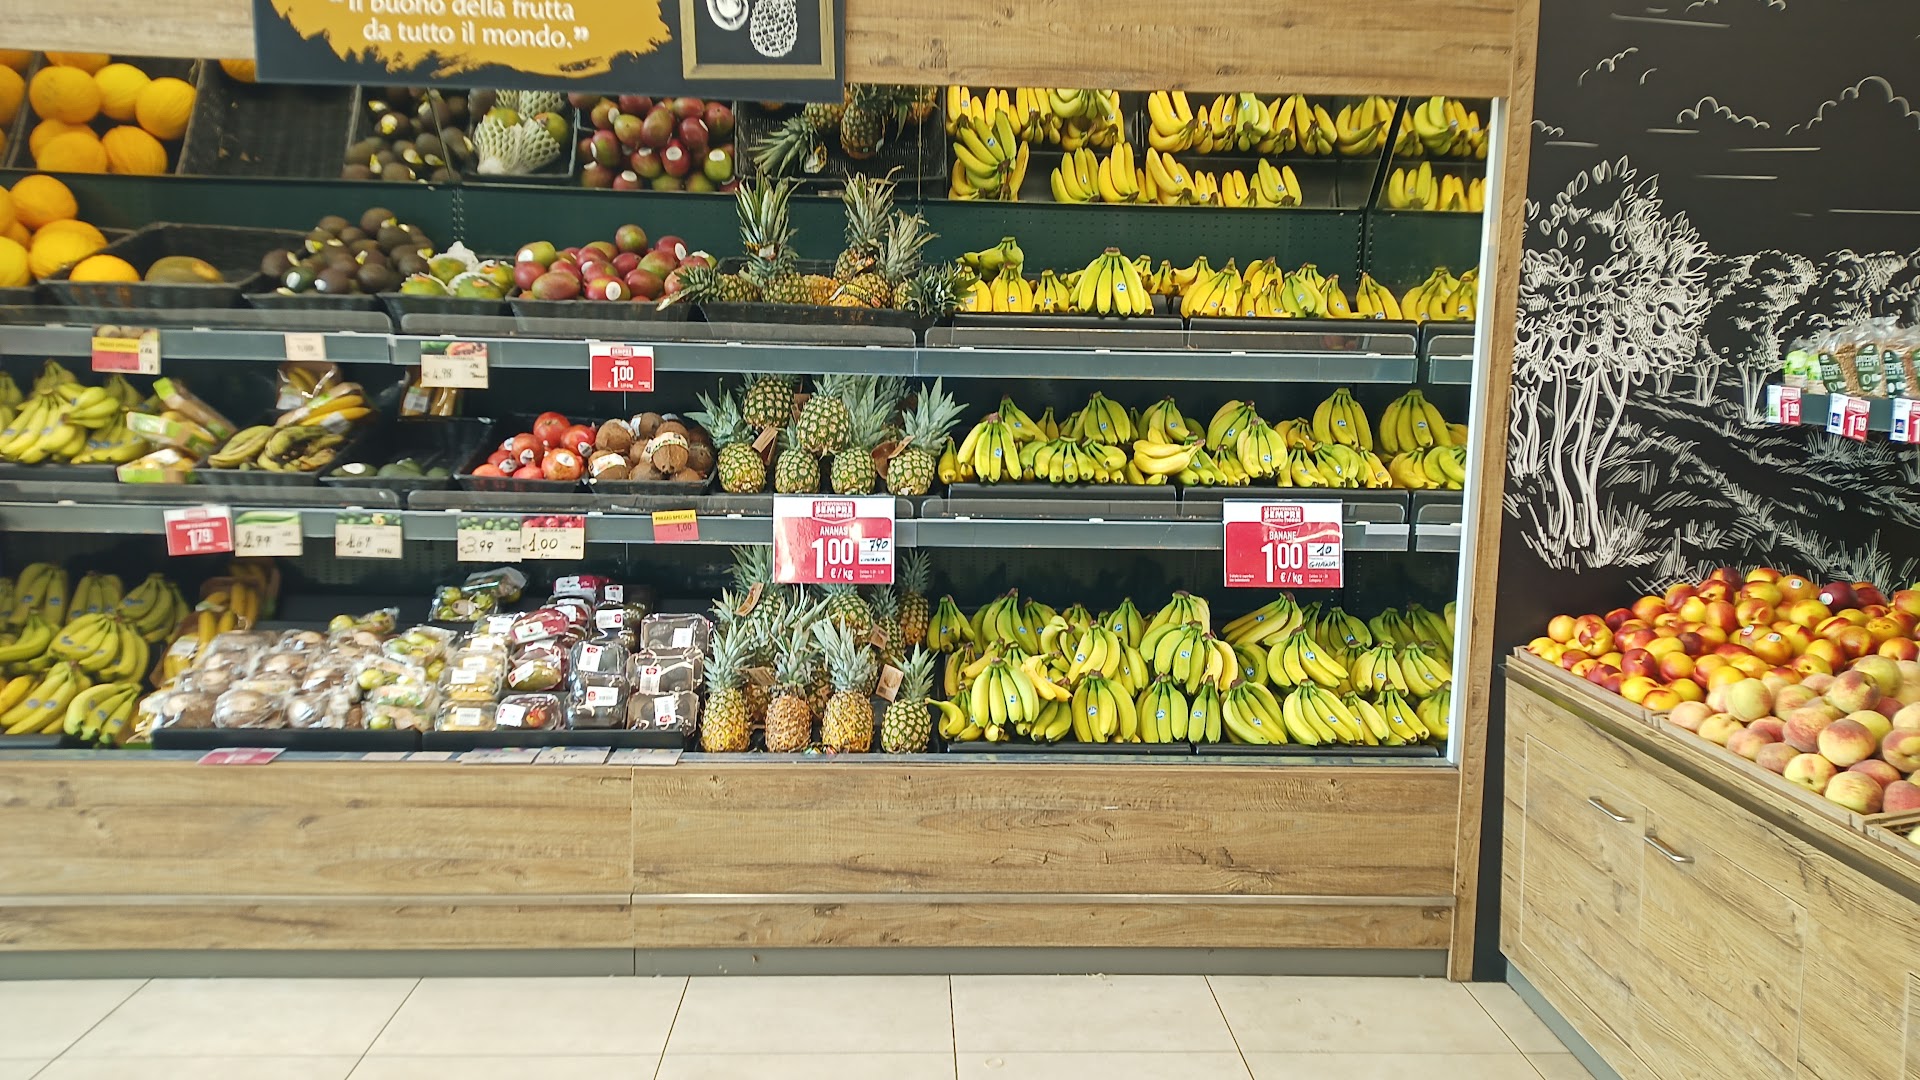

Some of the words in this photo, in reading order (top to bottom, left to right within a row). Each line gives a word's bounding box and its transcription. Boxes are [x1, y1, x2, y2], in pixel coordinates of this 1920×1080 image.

[452, 0, 506, 18] della
[363, 17, 392, 41] da
[398, 22, 456, 43] tutto
[462, 20, 475, 44] il
[820, 526, 848, 536] ANANAS
[1269, 531, 1296, 541] BANANE
[812, 538, 854, 579] 1,00
[1261, 543, 1303, 583] 1,00
